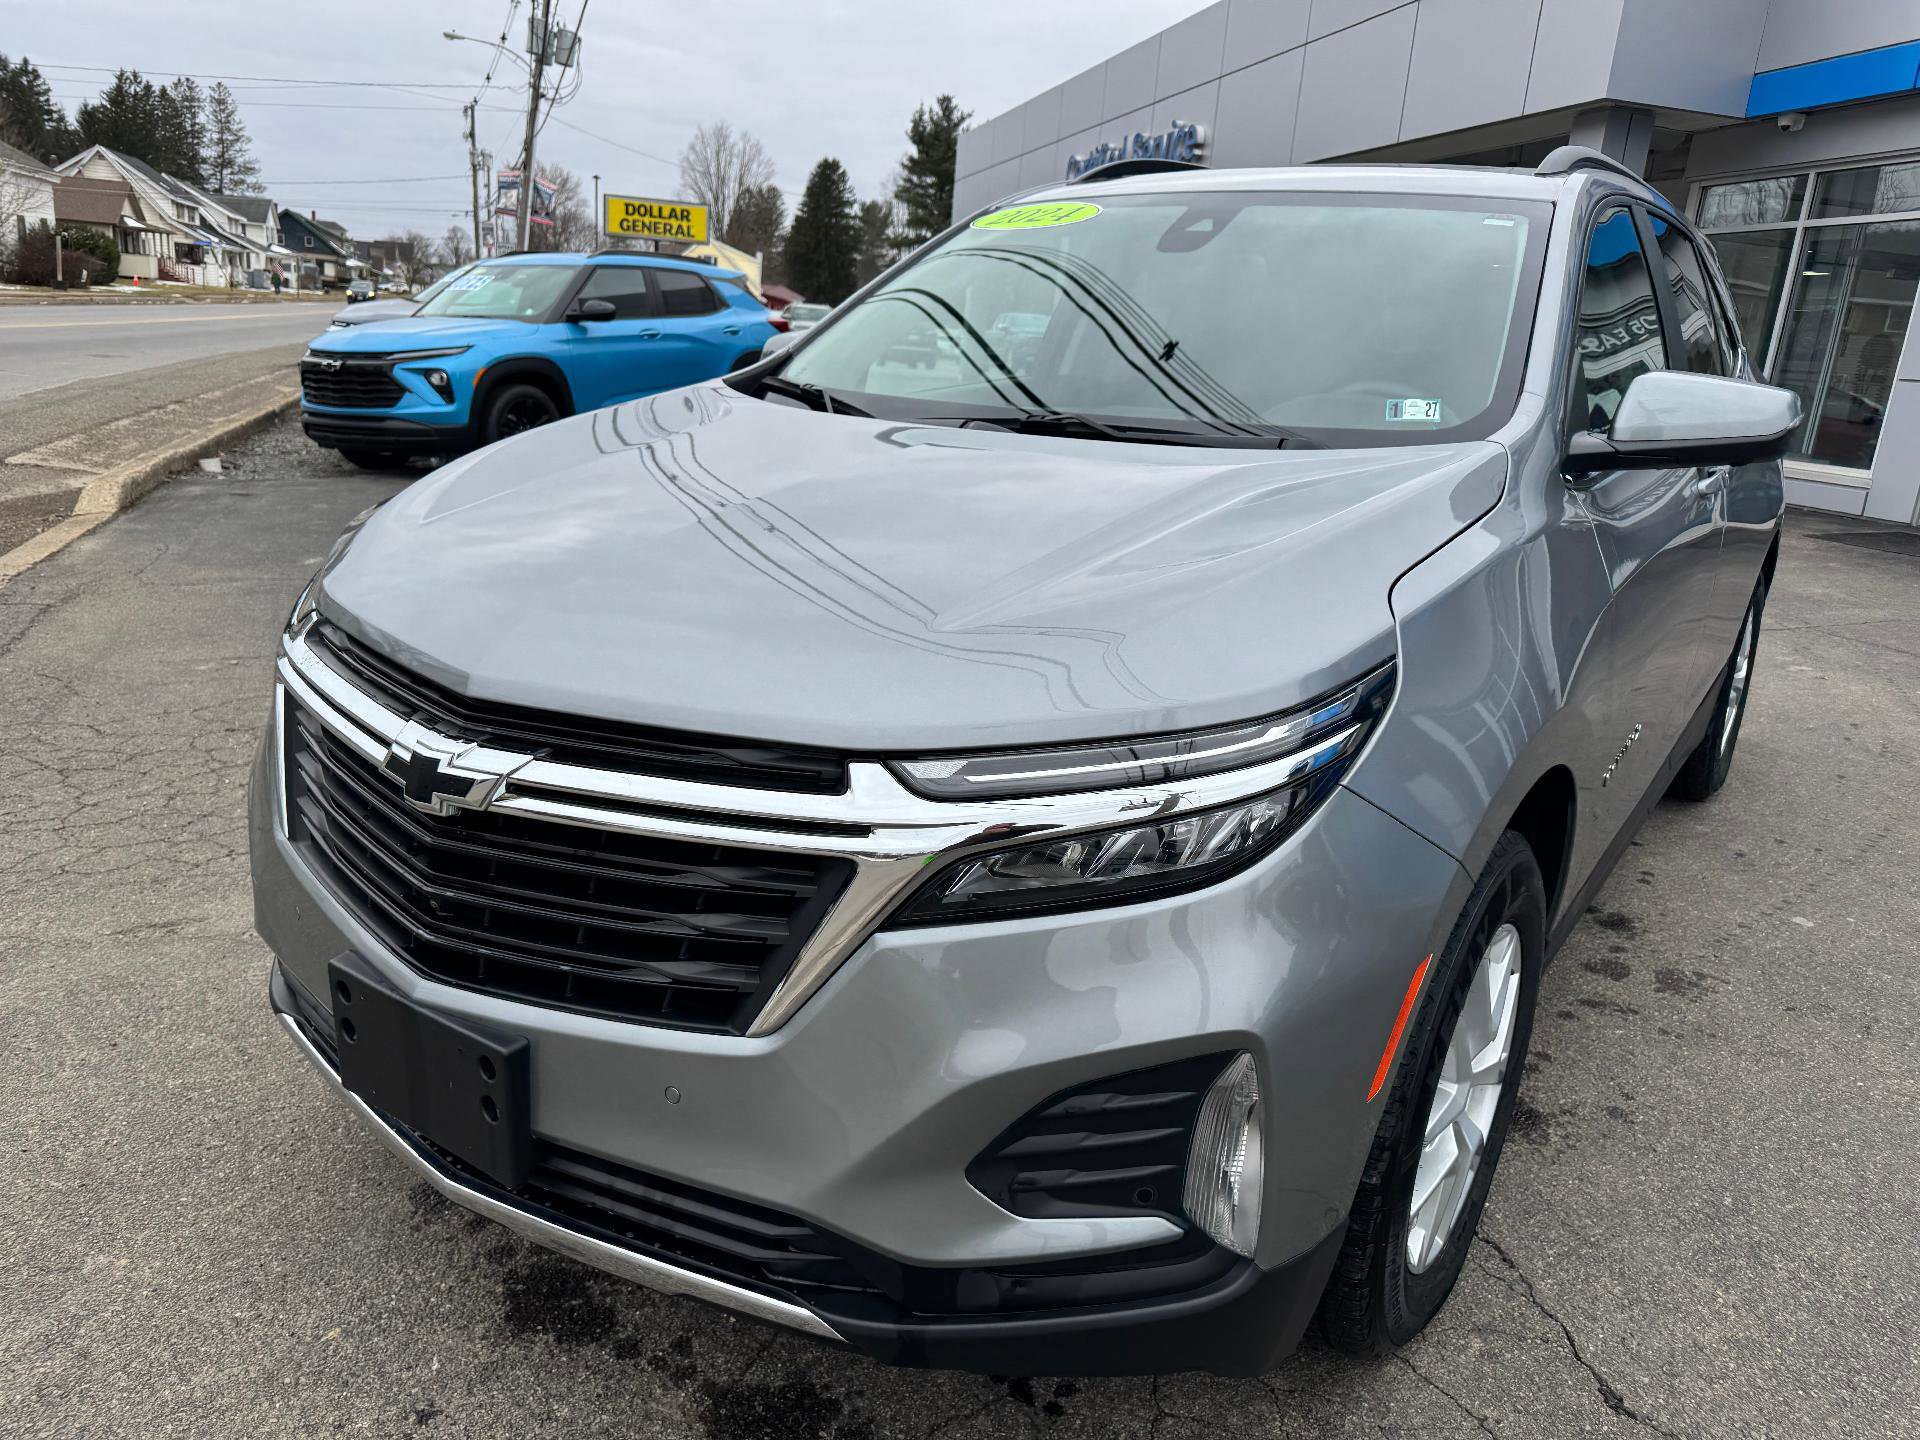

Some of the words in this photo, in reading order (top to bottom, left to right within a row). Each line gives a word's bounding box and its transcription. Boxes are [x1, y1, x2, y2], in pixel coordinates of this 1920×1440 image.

[624, 202, 691, 222] DOLLAR
[984, 206, 1085, 226] 2024
[619, 218, 696, 238] GENERAL
[1425, 401, 1437, 418] 27
